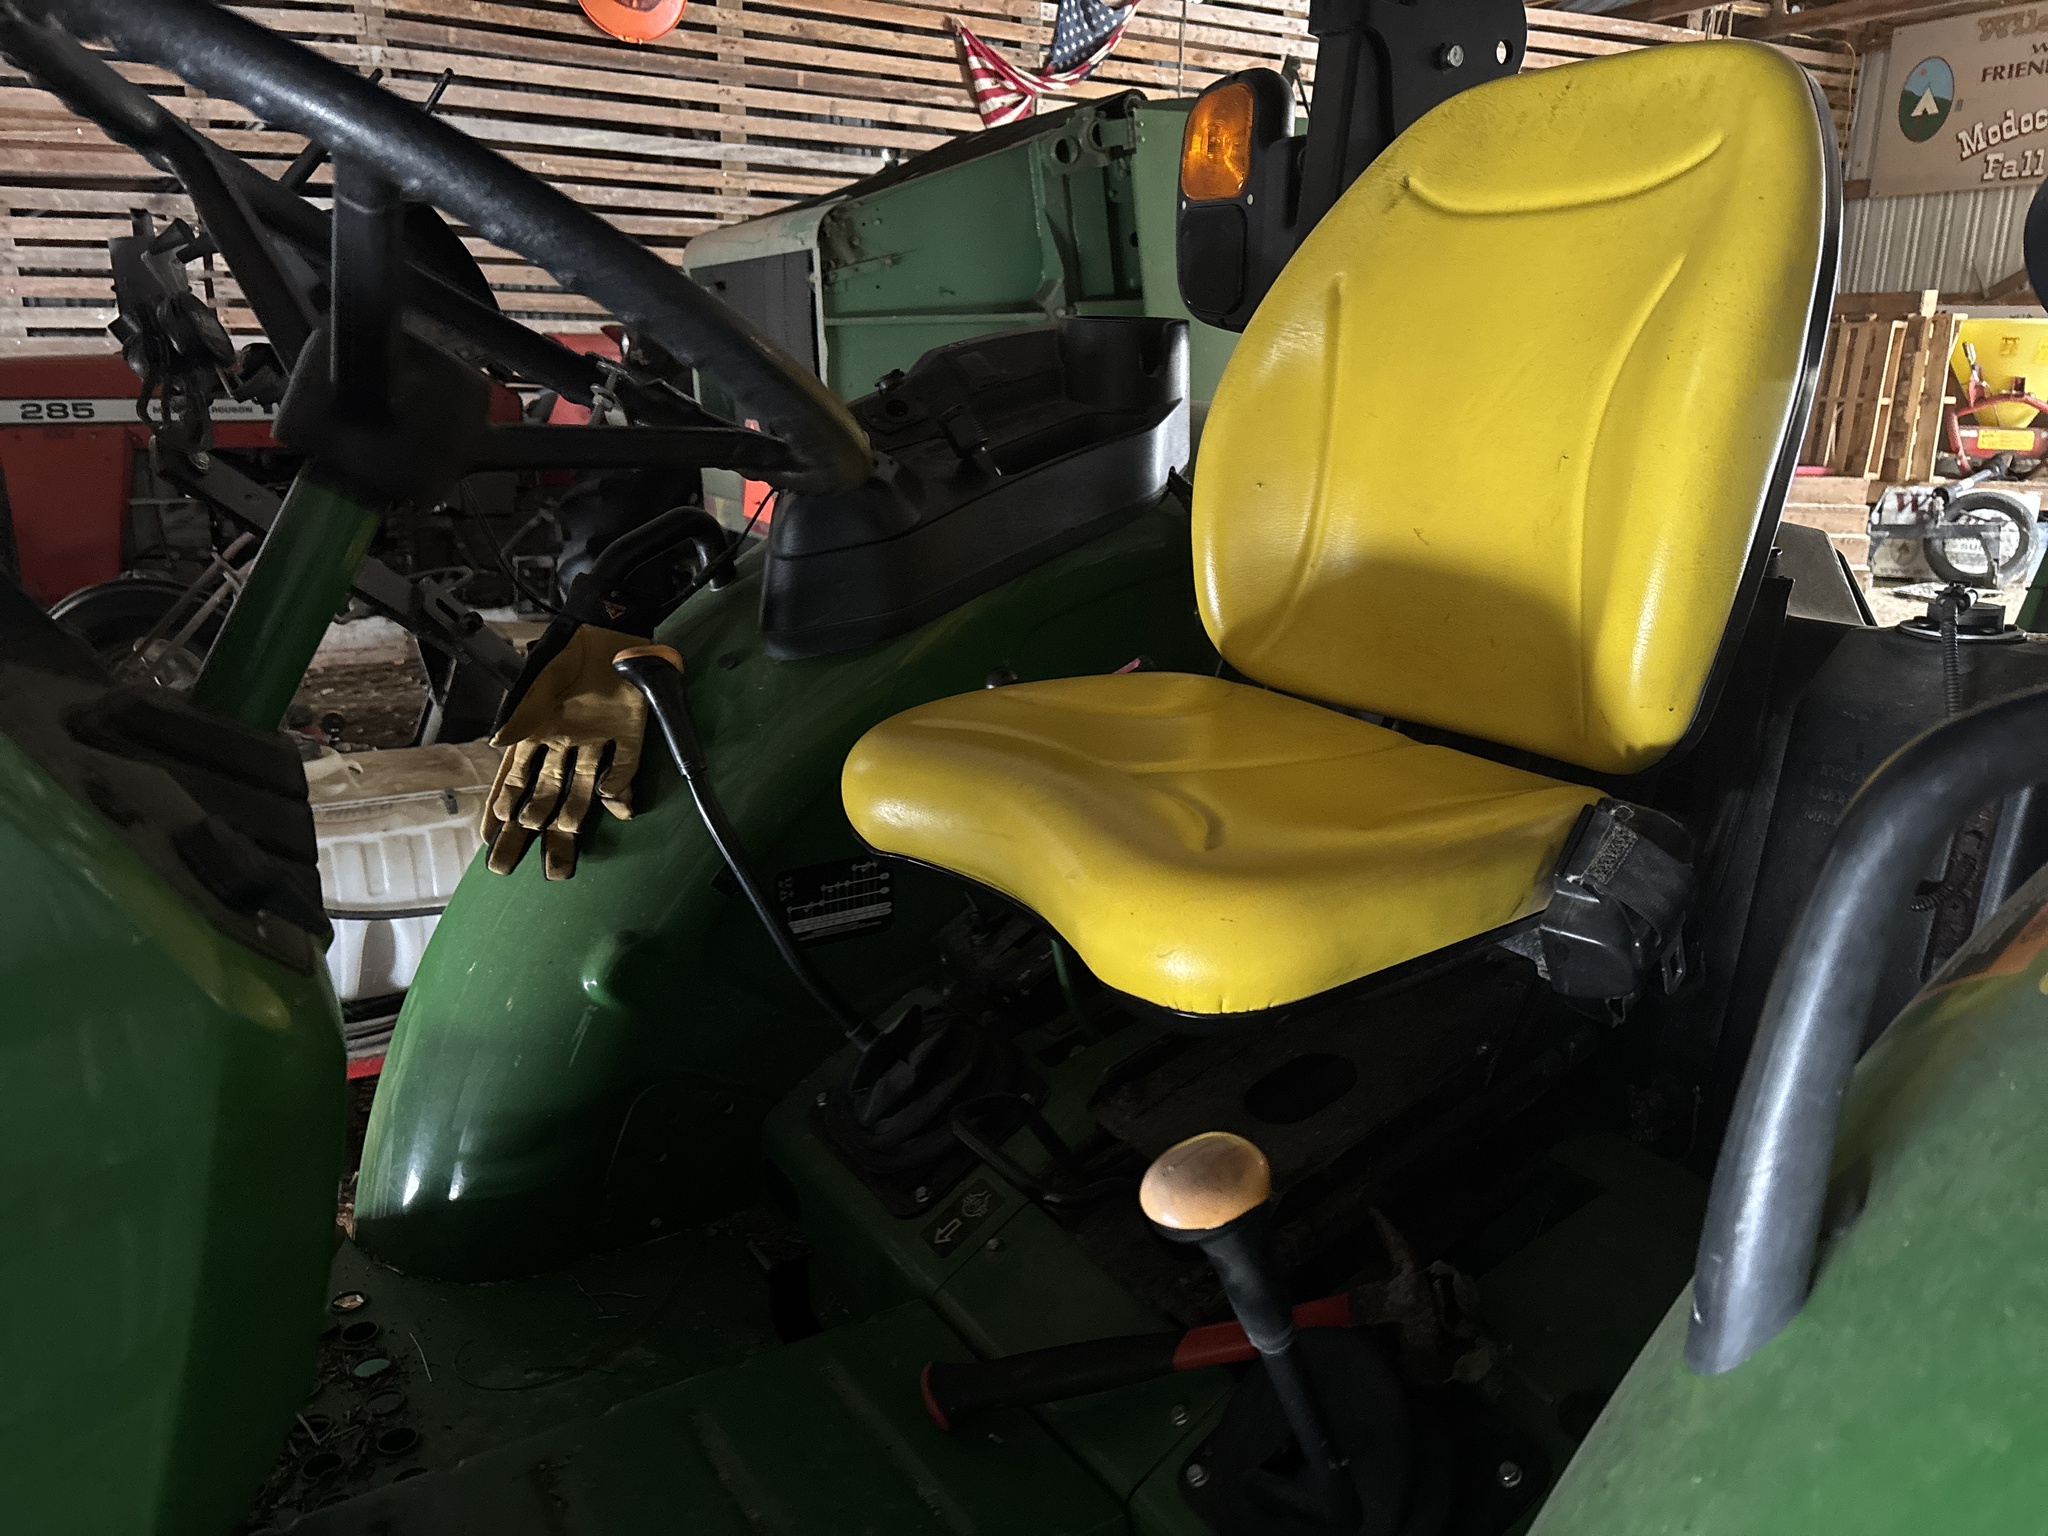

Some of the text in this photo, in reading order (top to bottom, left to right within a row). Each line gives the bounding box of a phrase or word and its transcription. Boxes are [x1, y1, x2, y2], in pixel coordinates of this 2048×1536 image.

[1956, 108, 2048, 161] Modoc
[1981, 148, 2045, 181] Fall
[21, 402, 95, 420] 285
